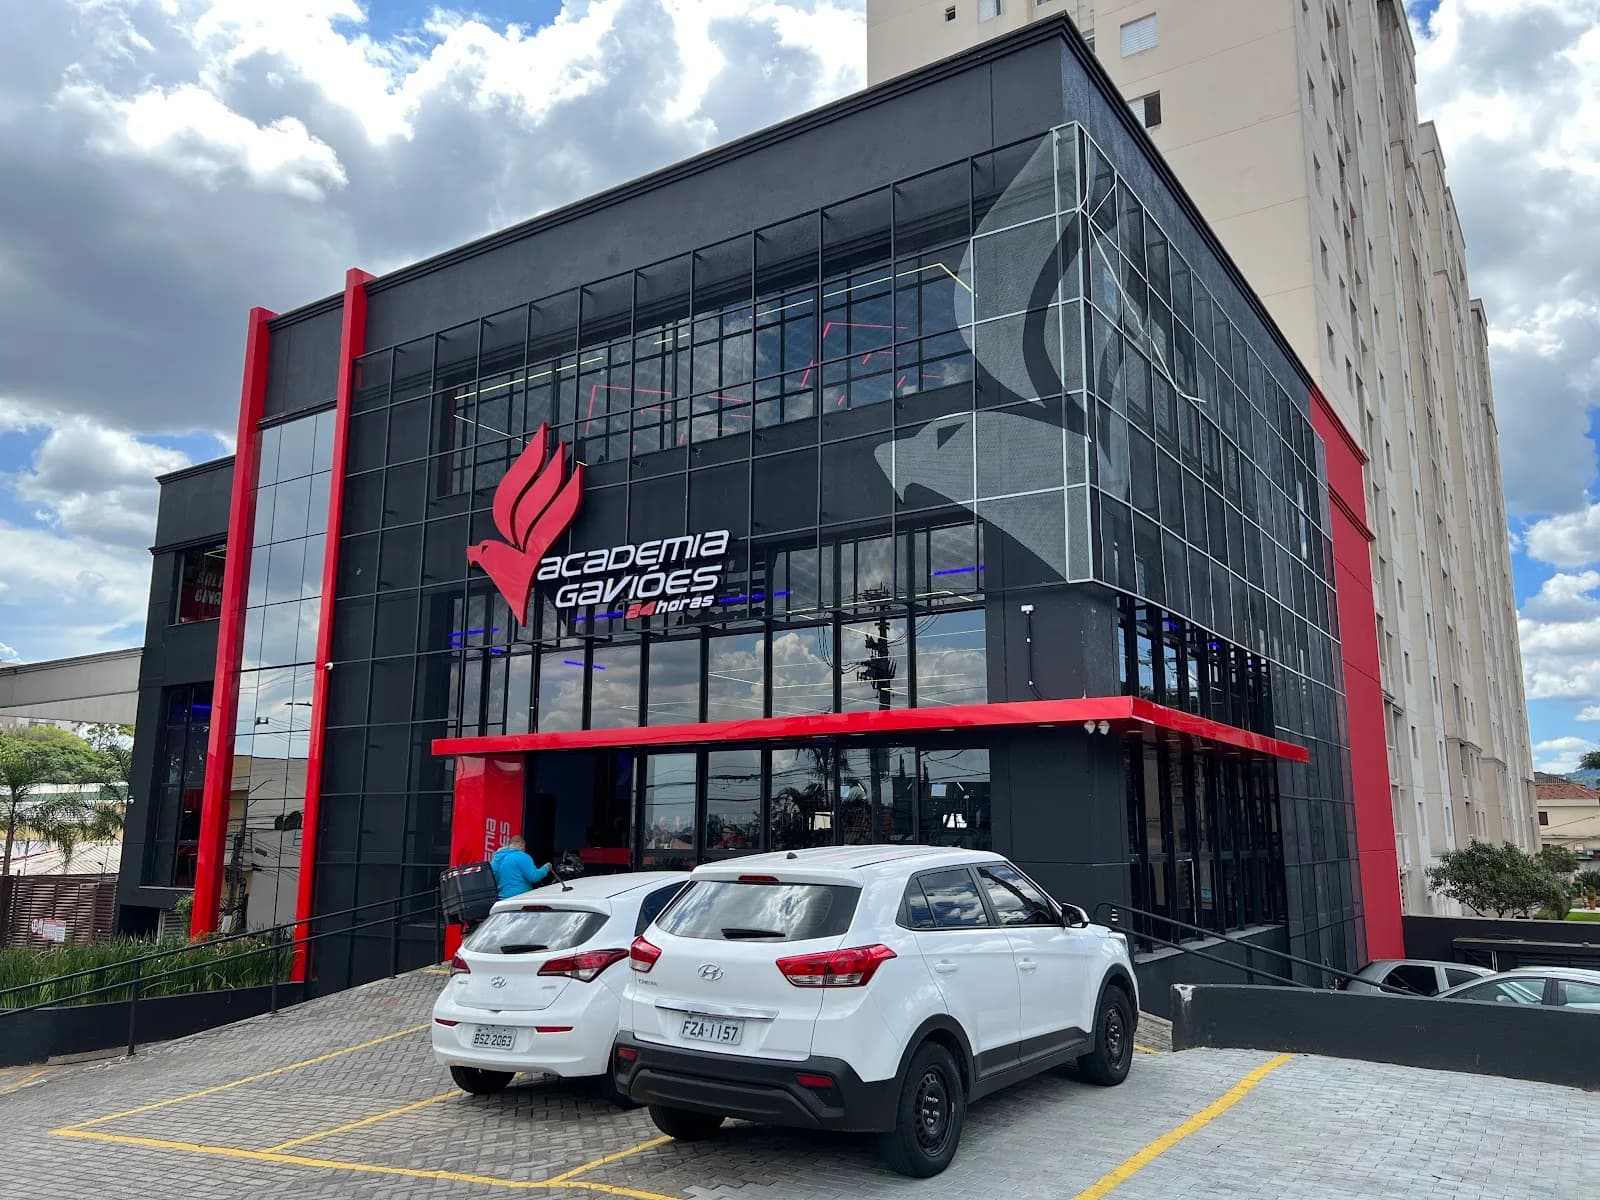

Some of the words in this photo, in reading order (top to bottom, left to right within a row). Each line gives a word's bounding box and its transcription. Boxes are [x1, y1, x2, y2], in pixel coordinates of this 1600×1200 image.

[537, 530, 730, 581] ACADEMIA
[625, 600, 656, 619] 24
[656, 595, 715, 615] horas
